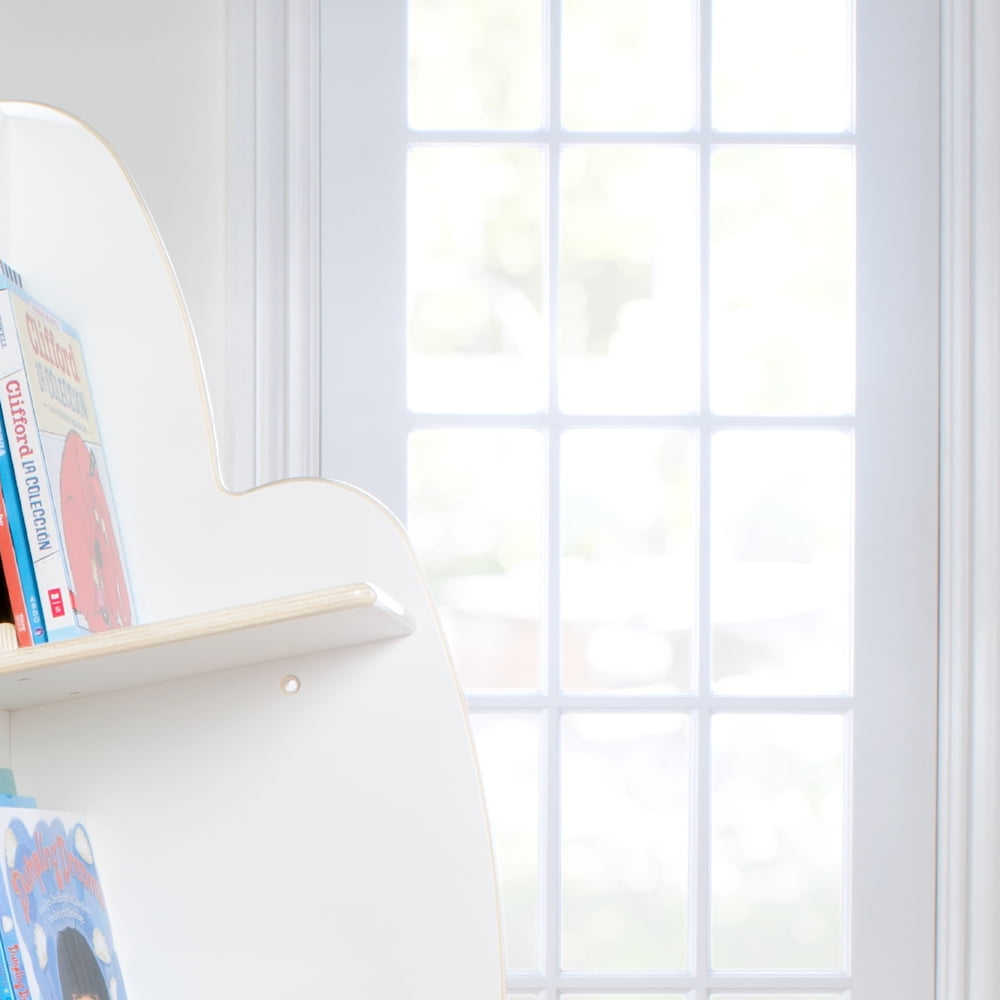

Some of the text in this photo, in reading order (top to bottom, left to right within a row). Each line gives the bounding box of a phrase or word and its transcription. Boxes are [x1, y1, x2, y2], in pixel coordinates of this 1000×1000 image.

[5, 378, 52, 550] Clifford LA COLECCIÓN
[7, 944, 25, 989] Dumpling
